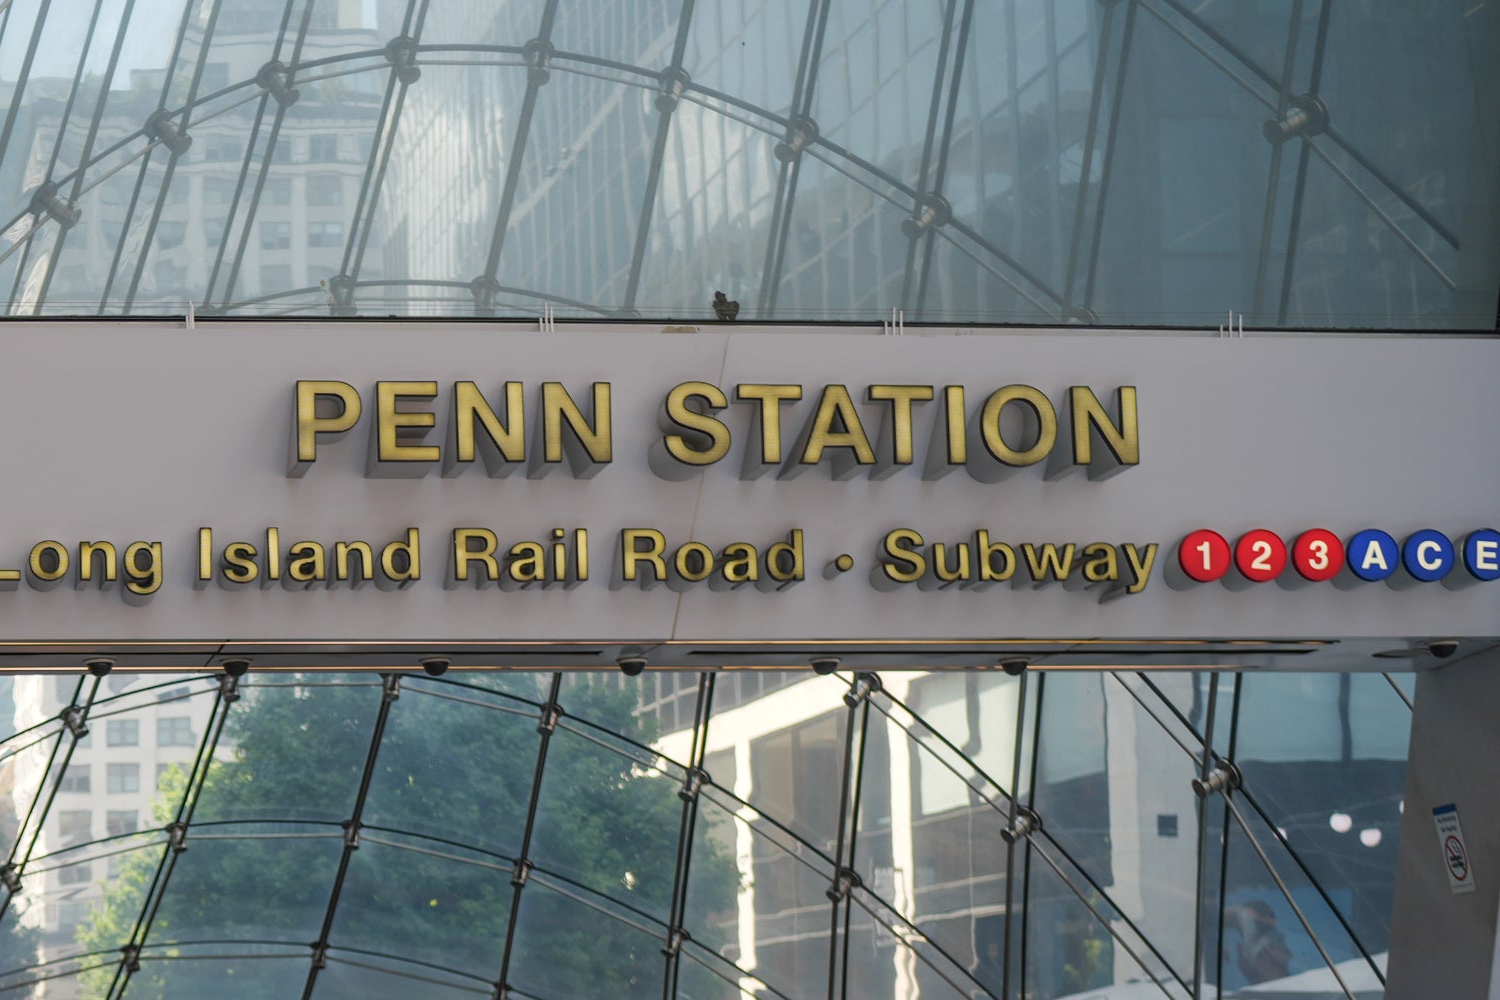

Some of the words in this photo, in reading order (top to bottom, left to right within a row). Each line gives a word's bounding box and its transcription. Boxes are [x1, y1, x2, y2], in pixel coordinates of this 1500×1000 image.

[295, 380, 612, 464] PENN
[663, 380, 1140, 467] STATION
[198, 527, 421, 583] Island
[452, 527, 589, 583] Rail
[621, 527, 805, 583] Road
[883, 527, 1159, 595] Subway
[1476, 540, 1499, 571] E
